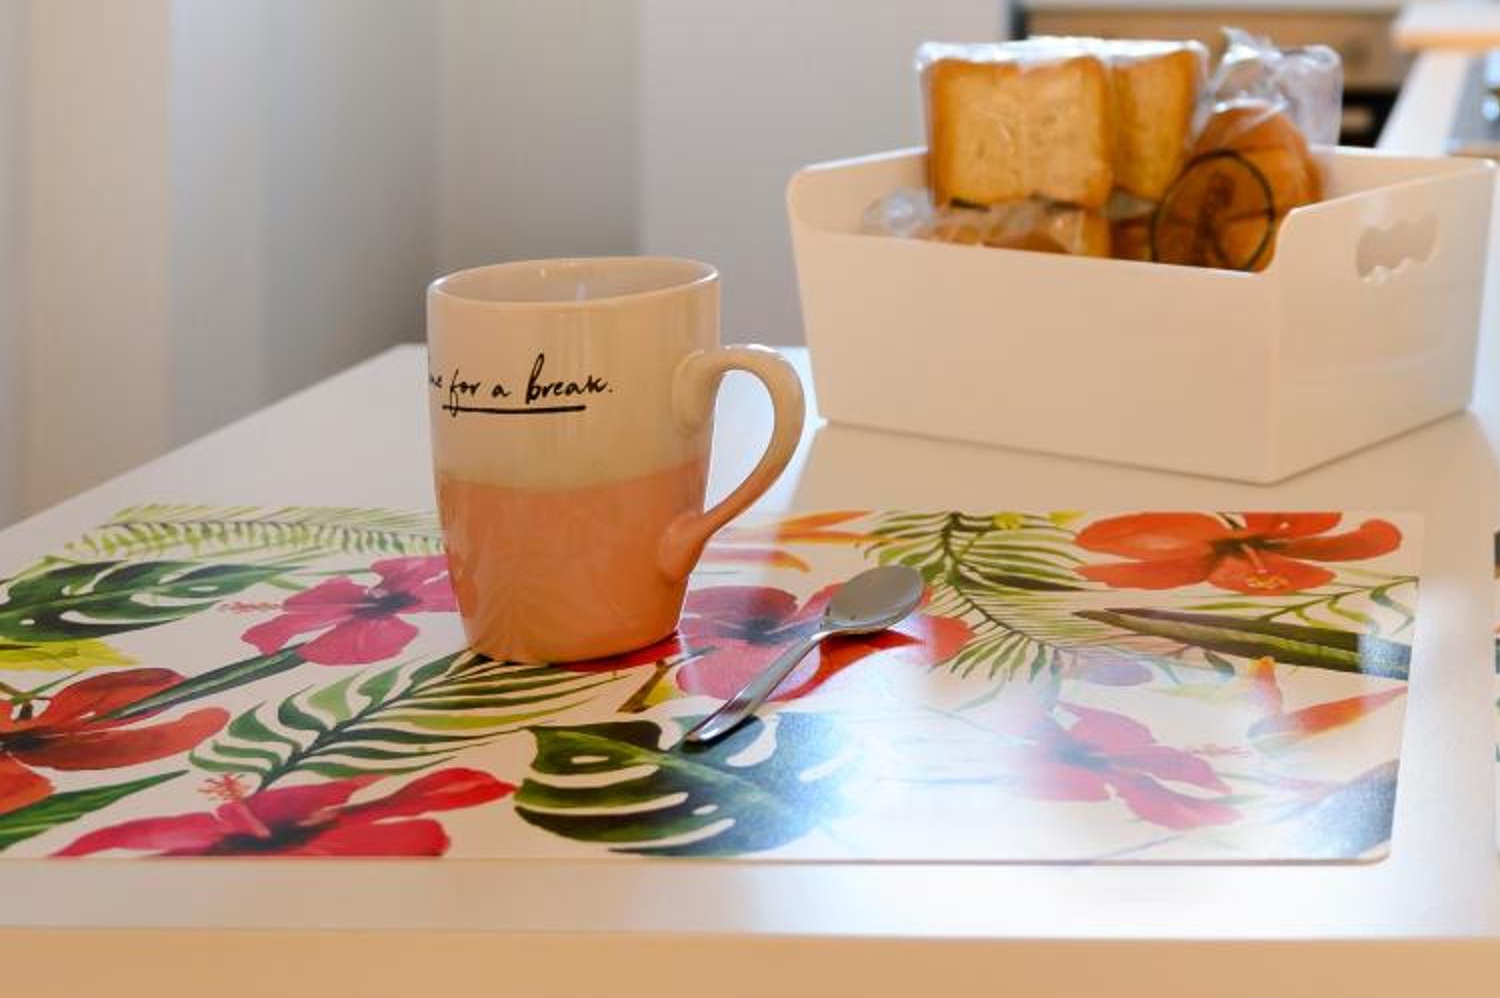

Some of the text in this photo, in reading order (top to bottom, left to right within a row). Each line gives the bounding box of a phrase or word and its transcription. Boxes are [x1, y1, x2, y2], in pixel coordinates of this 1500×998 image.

[450, 353, 613, 417] for a break.
